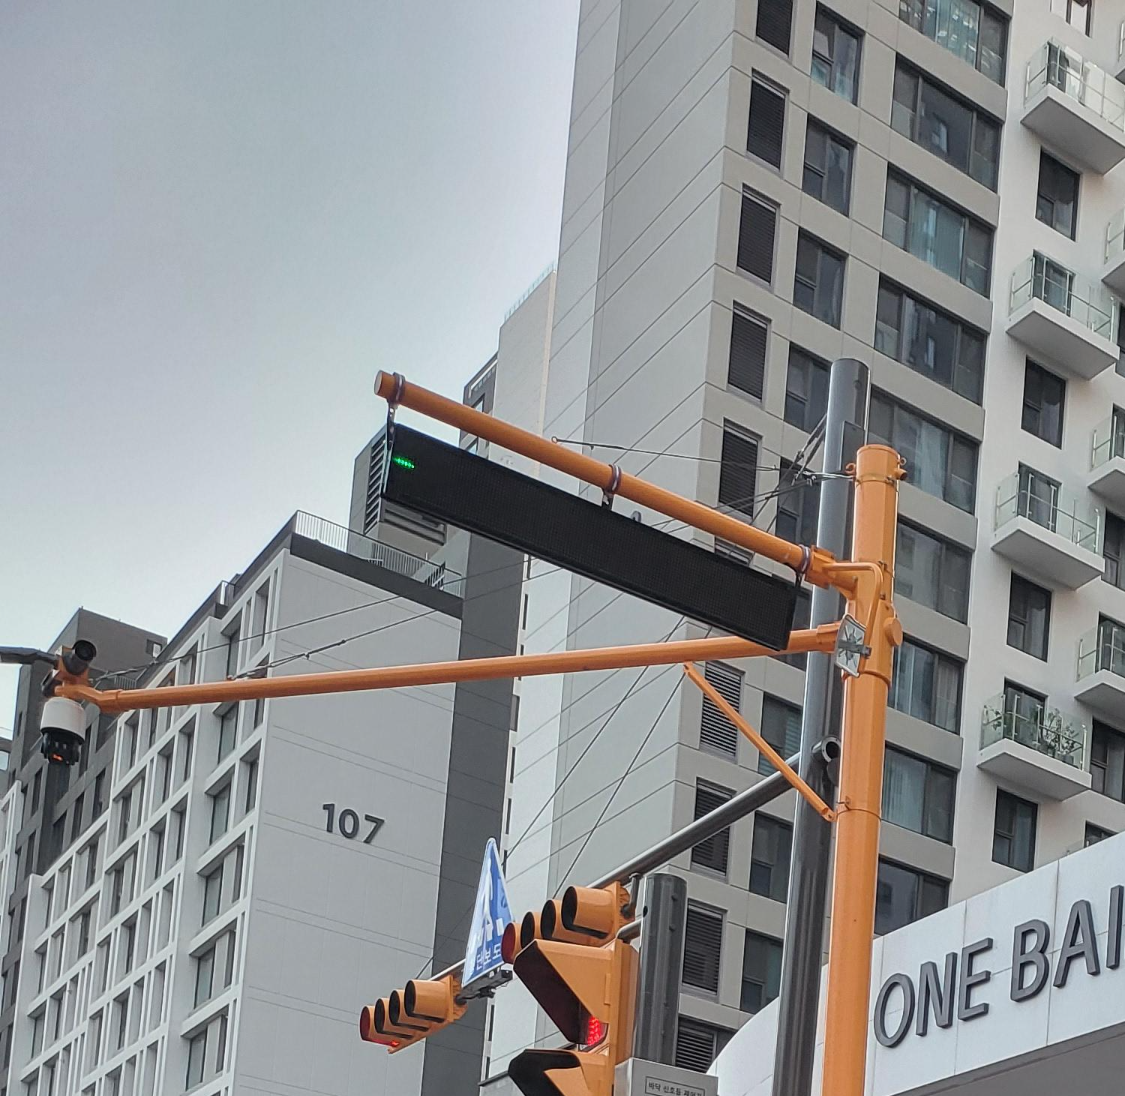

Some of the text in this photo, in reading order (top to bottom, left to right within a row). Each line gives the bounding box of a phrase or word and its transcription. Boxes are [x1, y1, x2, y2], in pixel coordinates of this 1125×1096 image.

[322, 803, 385, 844] 107
[873, 937, 993, 1048] ONE
[648, 1081, 661, 1092] 바닥
